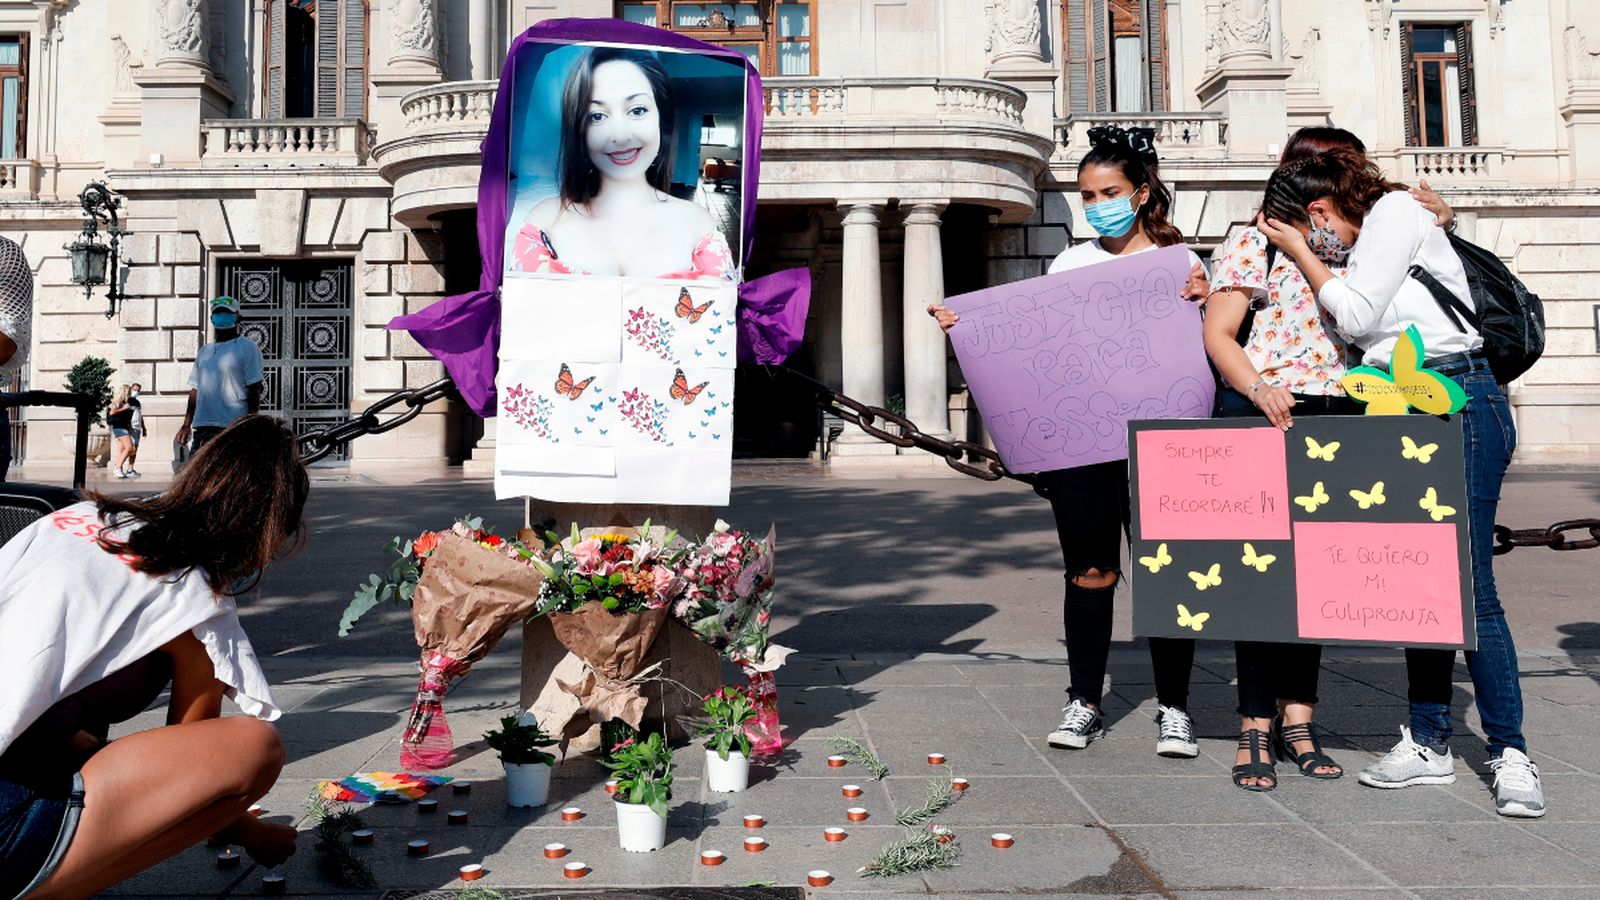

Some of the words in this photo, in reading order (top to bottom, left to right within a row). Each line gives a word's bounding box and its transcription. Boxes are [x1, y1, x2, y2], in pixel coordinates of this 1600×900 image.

[1022, 329, 1160, 402] para
[1164, 442, 1235, 463] SIEMPRE
[1196, 473, 1222, 486] TE
[1324, 545, 1347, 565] TE
[1356, 544, 1430, 566] QUIERO
